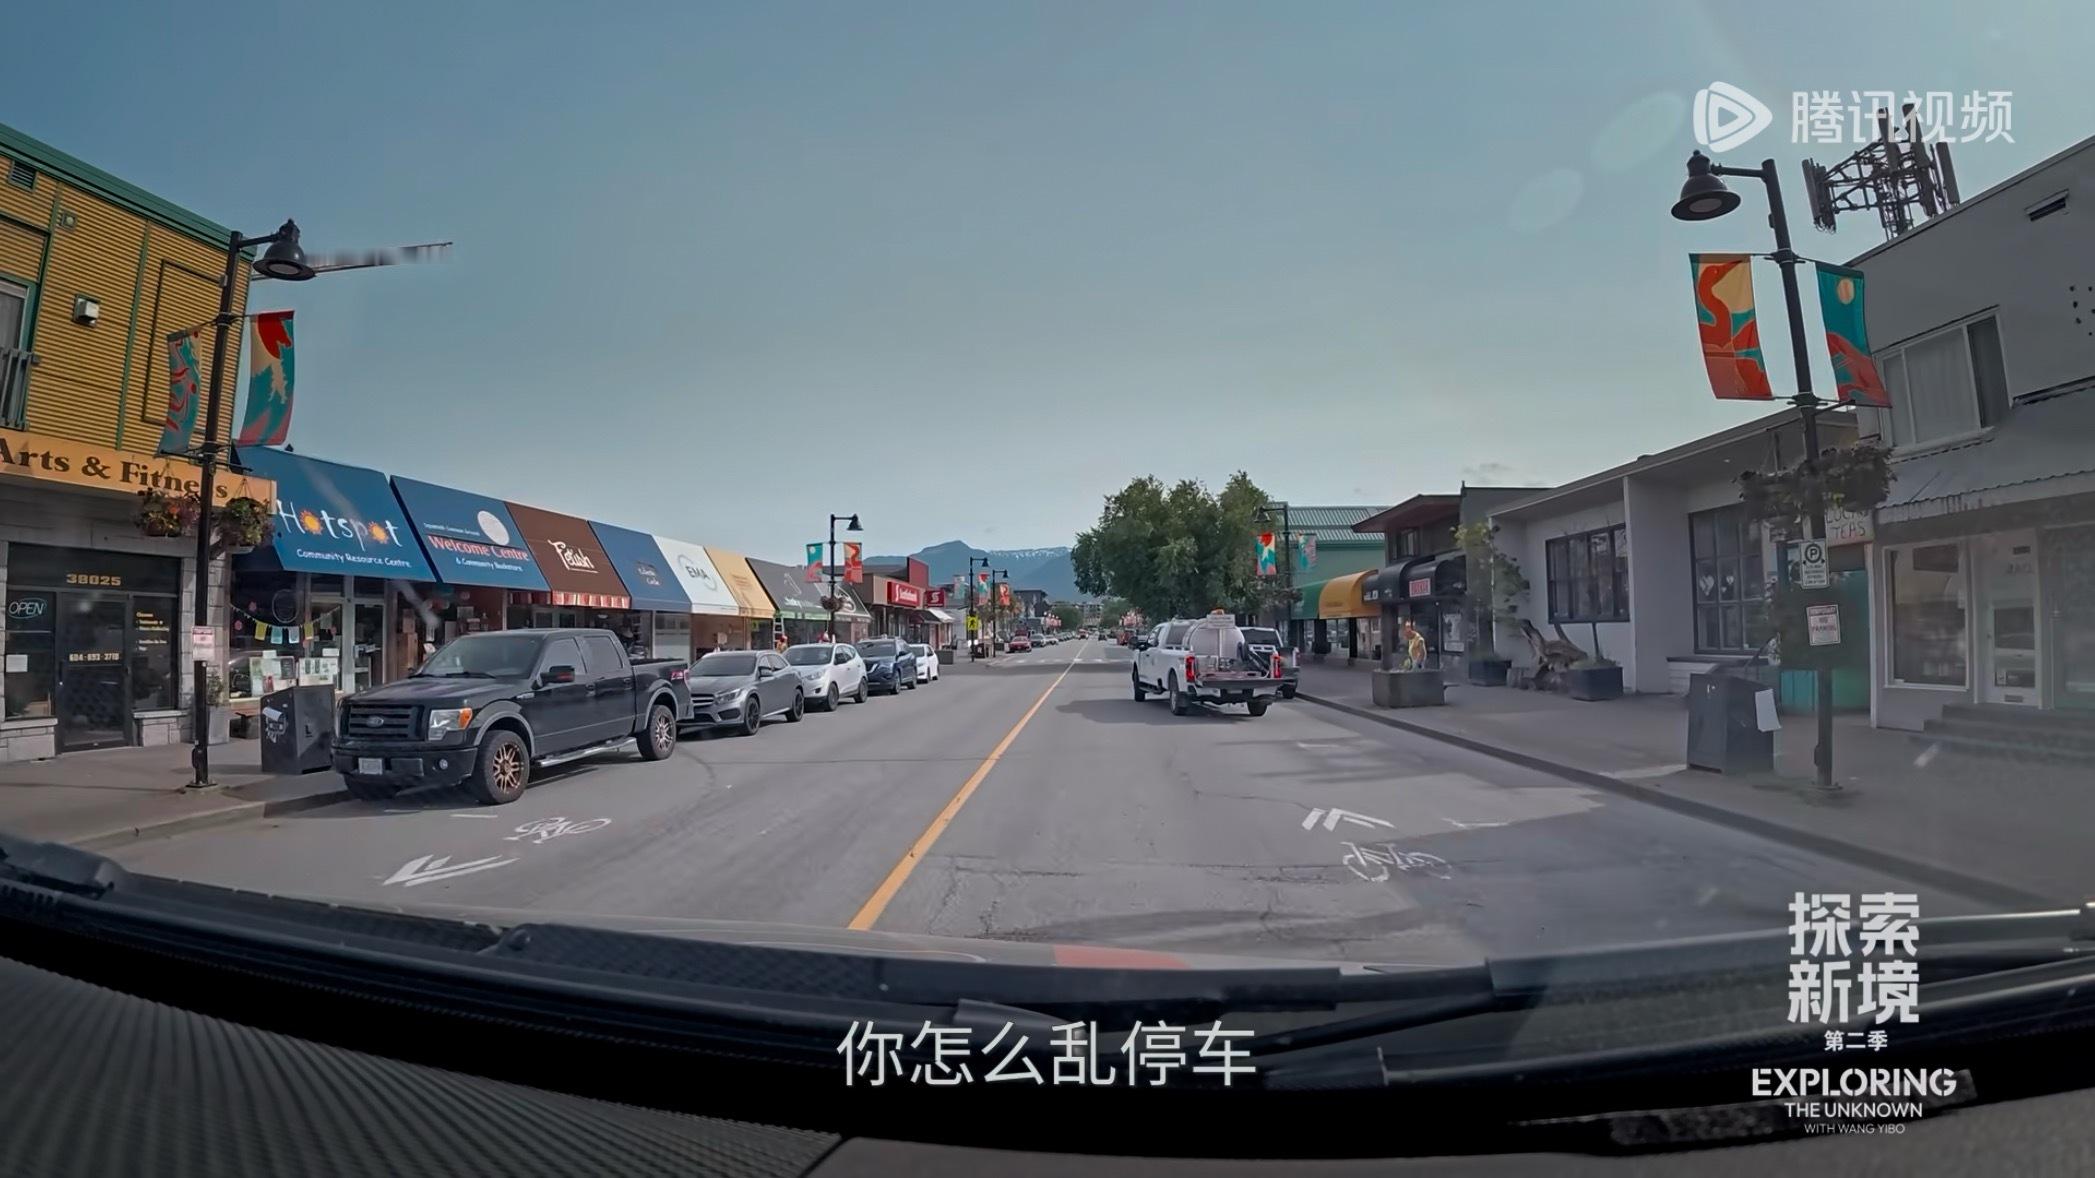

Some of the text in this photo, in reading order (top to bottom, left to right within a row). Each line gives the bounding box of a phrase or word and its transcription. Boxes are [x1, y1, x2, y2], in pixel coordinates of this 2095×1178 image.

[81, 455, 112, 480] &
[119, 461, 229, 499] Fitnes
[296, 548, 344, 563] Community
[345, 553, 384, 565] Resource
[427, 535, 530, 561] Welcome Centre
[66, 573, 122, 586] 38025
[8, 601, 45, 616] OPEN
